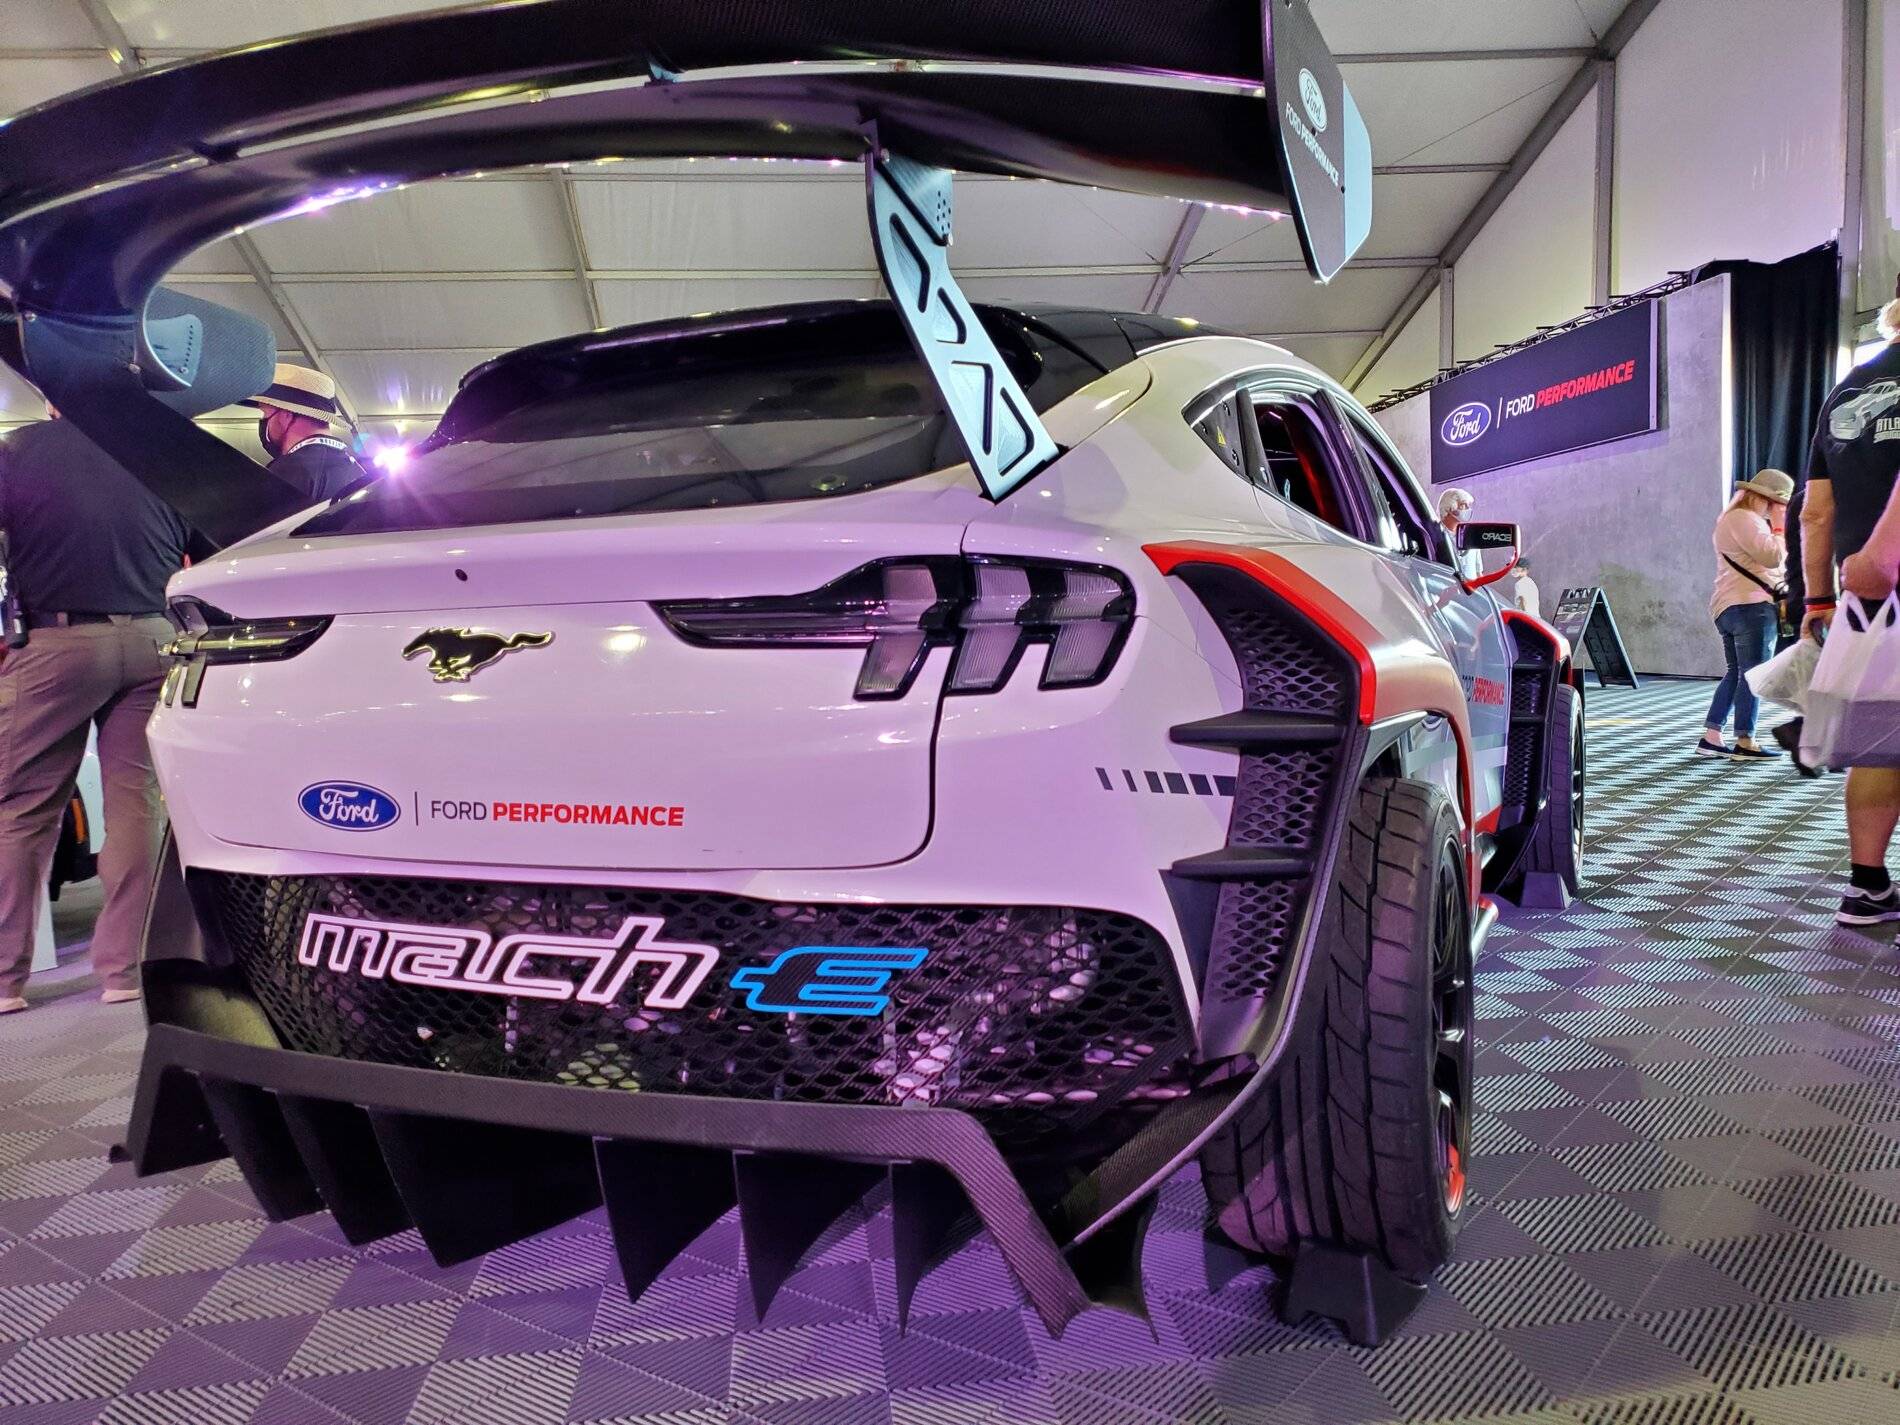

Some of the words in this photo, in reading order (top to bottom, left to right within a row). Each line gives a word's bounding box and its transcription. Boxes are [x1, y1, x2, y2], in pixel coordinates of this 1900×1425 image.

[1286, 102, 1302, 136] FORD
[1301, 123, 1339, 188] PERFORMANCE
[1450, 408, 1481, 441] Ford
[1505, 394, 1535, 419] FORD
[1536, 359, 1635, 408] PERFORMANCE
[318, 787, 380, 824] Ford
[431, 800, 488, 821] FORD
[492, 801, 685, 827] PERFORMANCE
[299, 912, 720, 1008] mach
